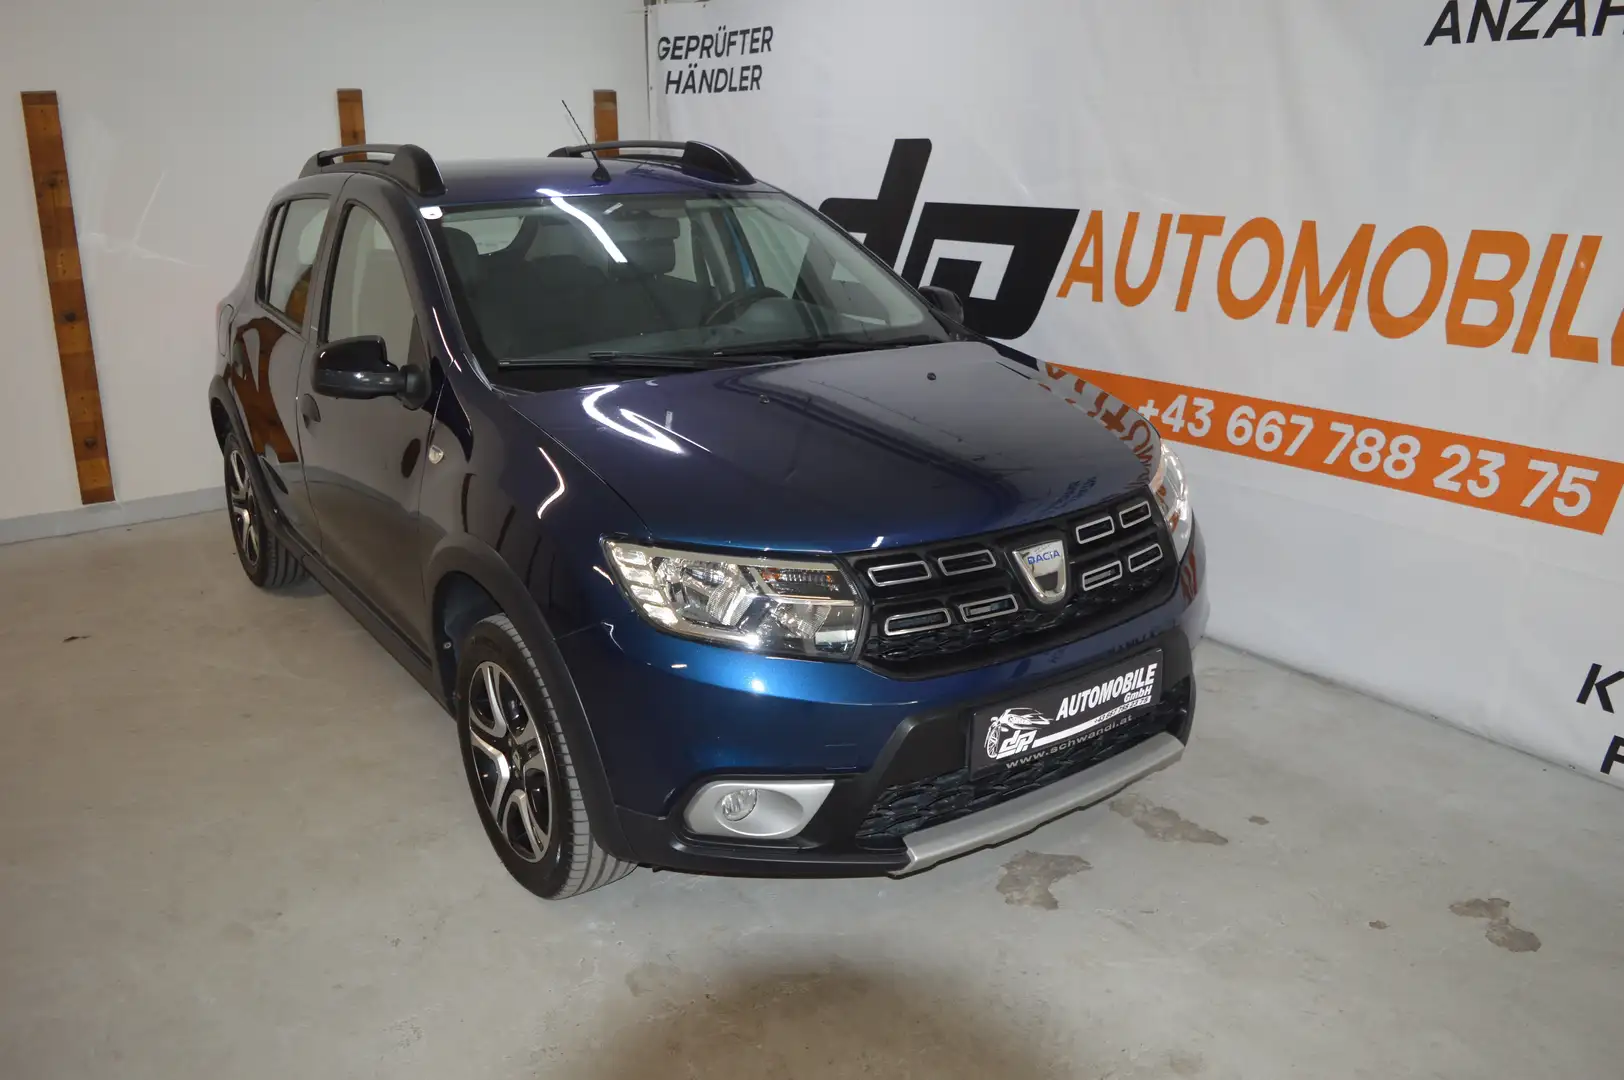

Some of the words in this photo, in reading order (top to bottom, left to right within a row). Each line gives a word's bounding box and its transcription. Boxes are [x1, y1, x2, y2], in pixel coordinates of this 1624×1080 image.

[657, 25, 774, 61] GEPRÜFTER
[664, 63, 763, 95] HÄNDLER
[1056, 209, 1624, 367] AUTOMOBIL
[1137, 394, 1216, 438] +43
[1226, 405, 1314, 457] 667
[1323, 421, 1421, 480] 788
[1432, 444, 1506, 498] 23
[1519, 458, 1600, 517] 75
[1055, 662, 1158, 722] AUTOMOBILE
[1123, 684, 1153, 703] GmbH
